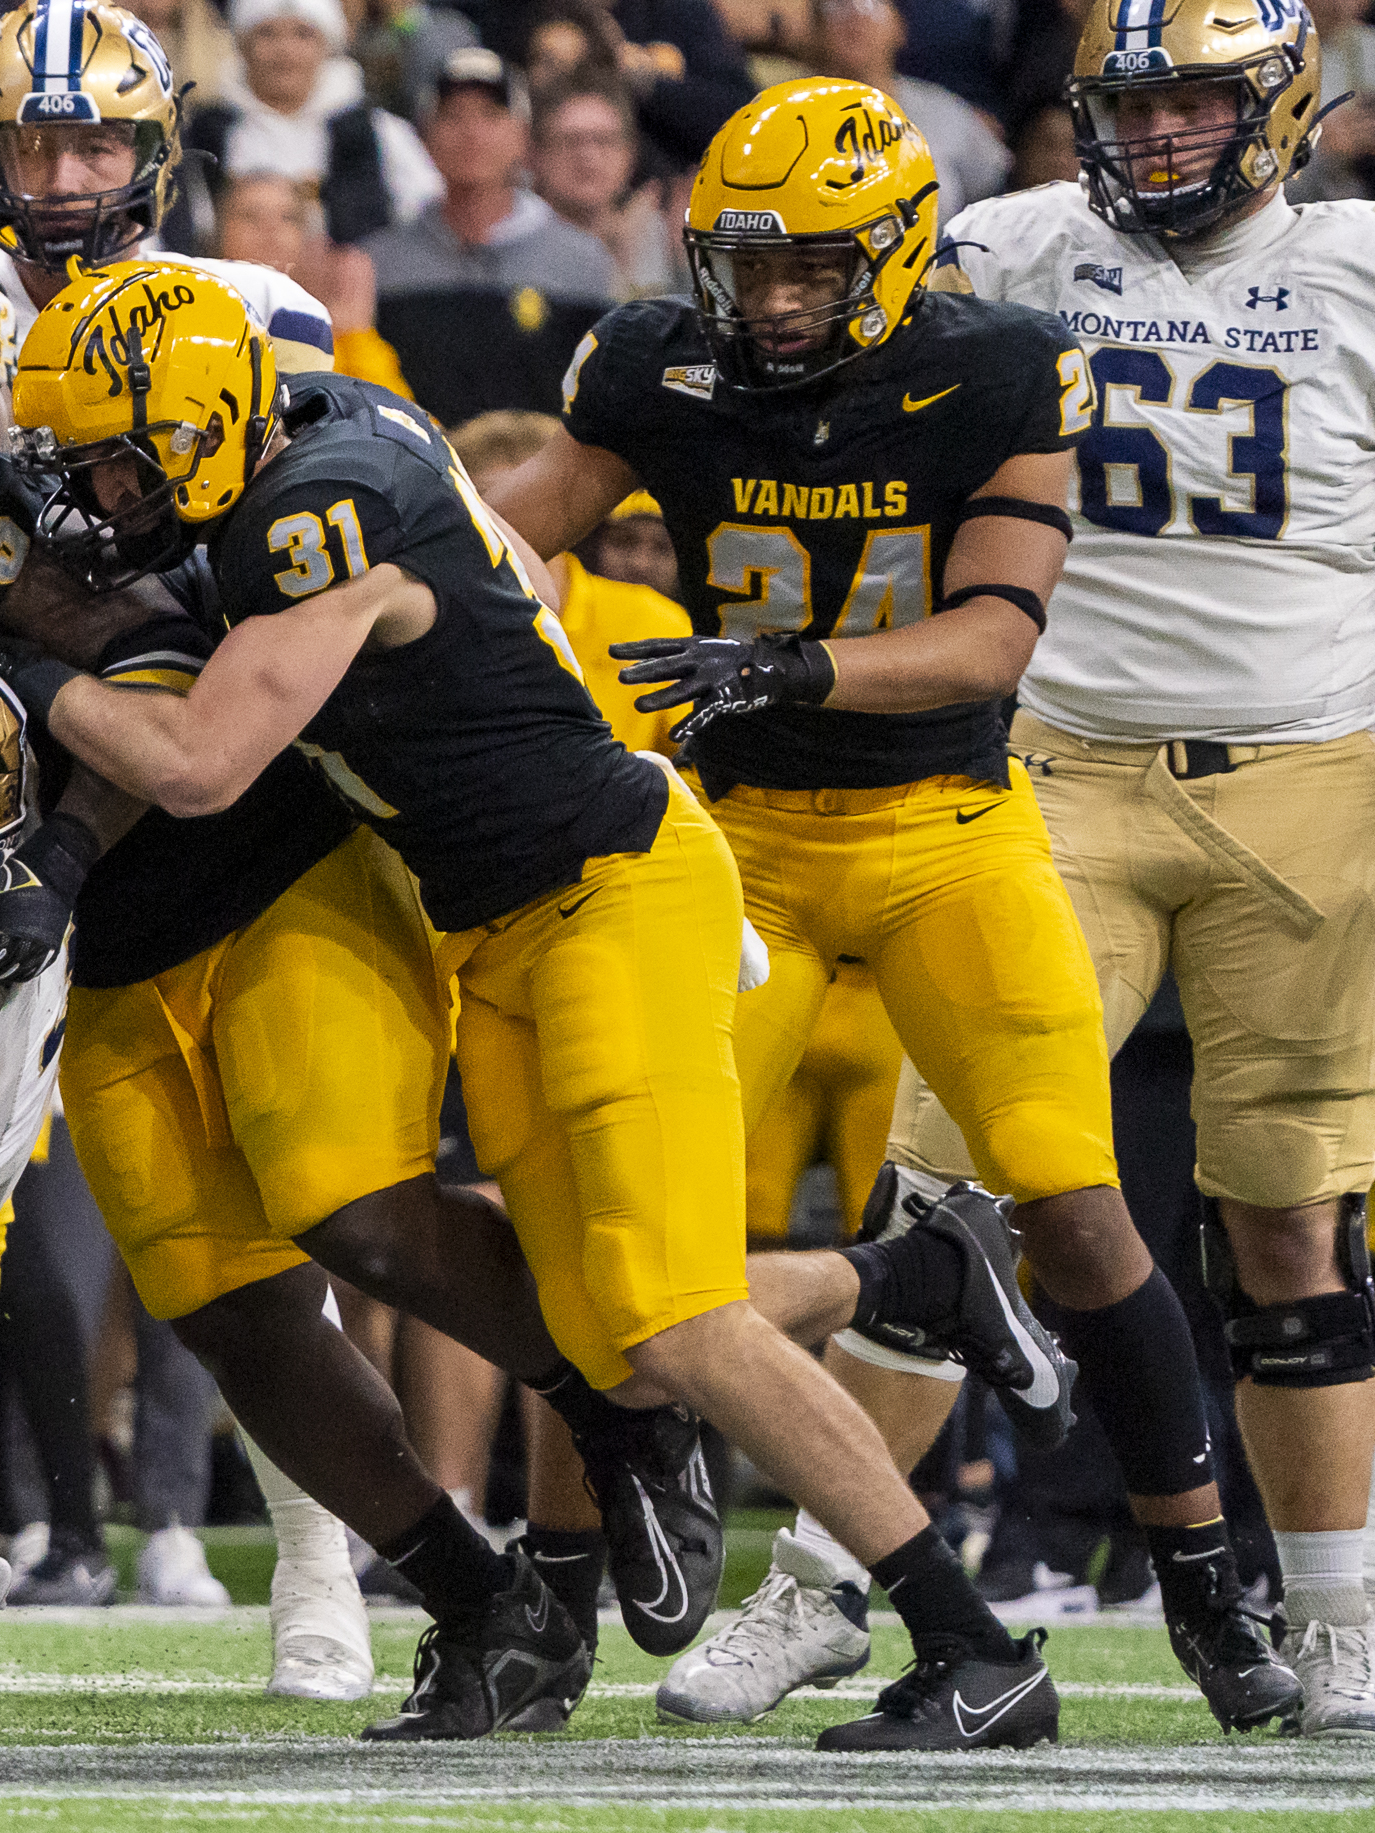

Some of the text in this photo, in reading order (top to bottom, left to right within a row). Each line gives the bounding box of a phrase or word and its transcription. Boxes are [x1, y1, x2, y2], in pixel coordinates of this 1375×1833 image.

[1116, 53, 1150, 70] 406
[38, 95, 75, 113] 406
[720, 213, 773, 229] IDAHO
[83, 284, 195, 397] Idaho
[1059, 311, 1319, 352] MONTANA STATE
[1078, 347, 1289, 540] 63
[732, 480, 907, 519] VANDALS
[266, 498, 370, 598] 31
